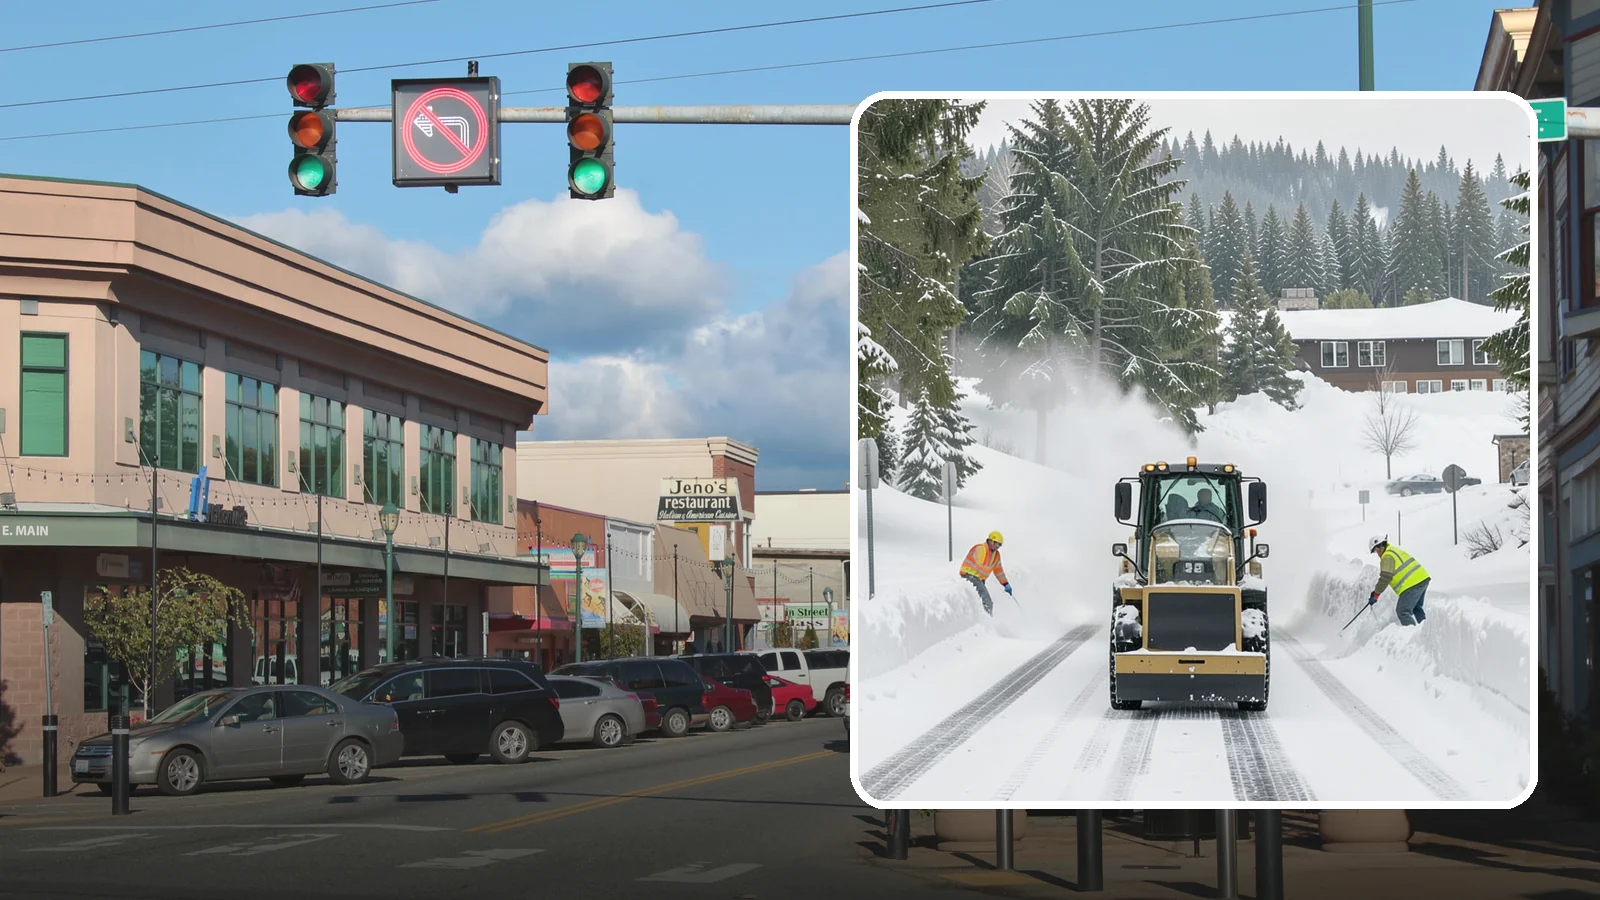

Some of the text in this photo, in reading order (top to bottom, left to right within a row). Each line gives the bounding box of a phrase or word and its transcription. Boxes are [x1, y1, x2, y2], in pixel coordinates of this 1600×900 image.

[669, 480, 727, 495] Jeno's
[665, 496, 731, 509] restaurant
[659, 510, 682, 520] Italian
[686, 510, 714, 519] American
[715, 510, 738, 519] Cuisine
[2, 525, 49, 536] E. MAIN
[798, 607, 828, 617] Street
